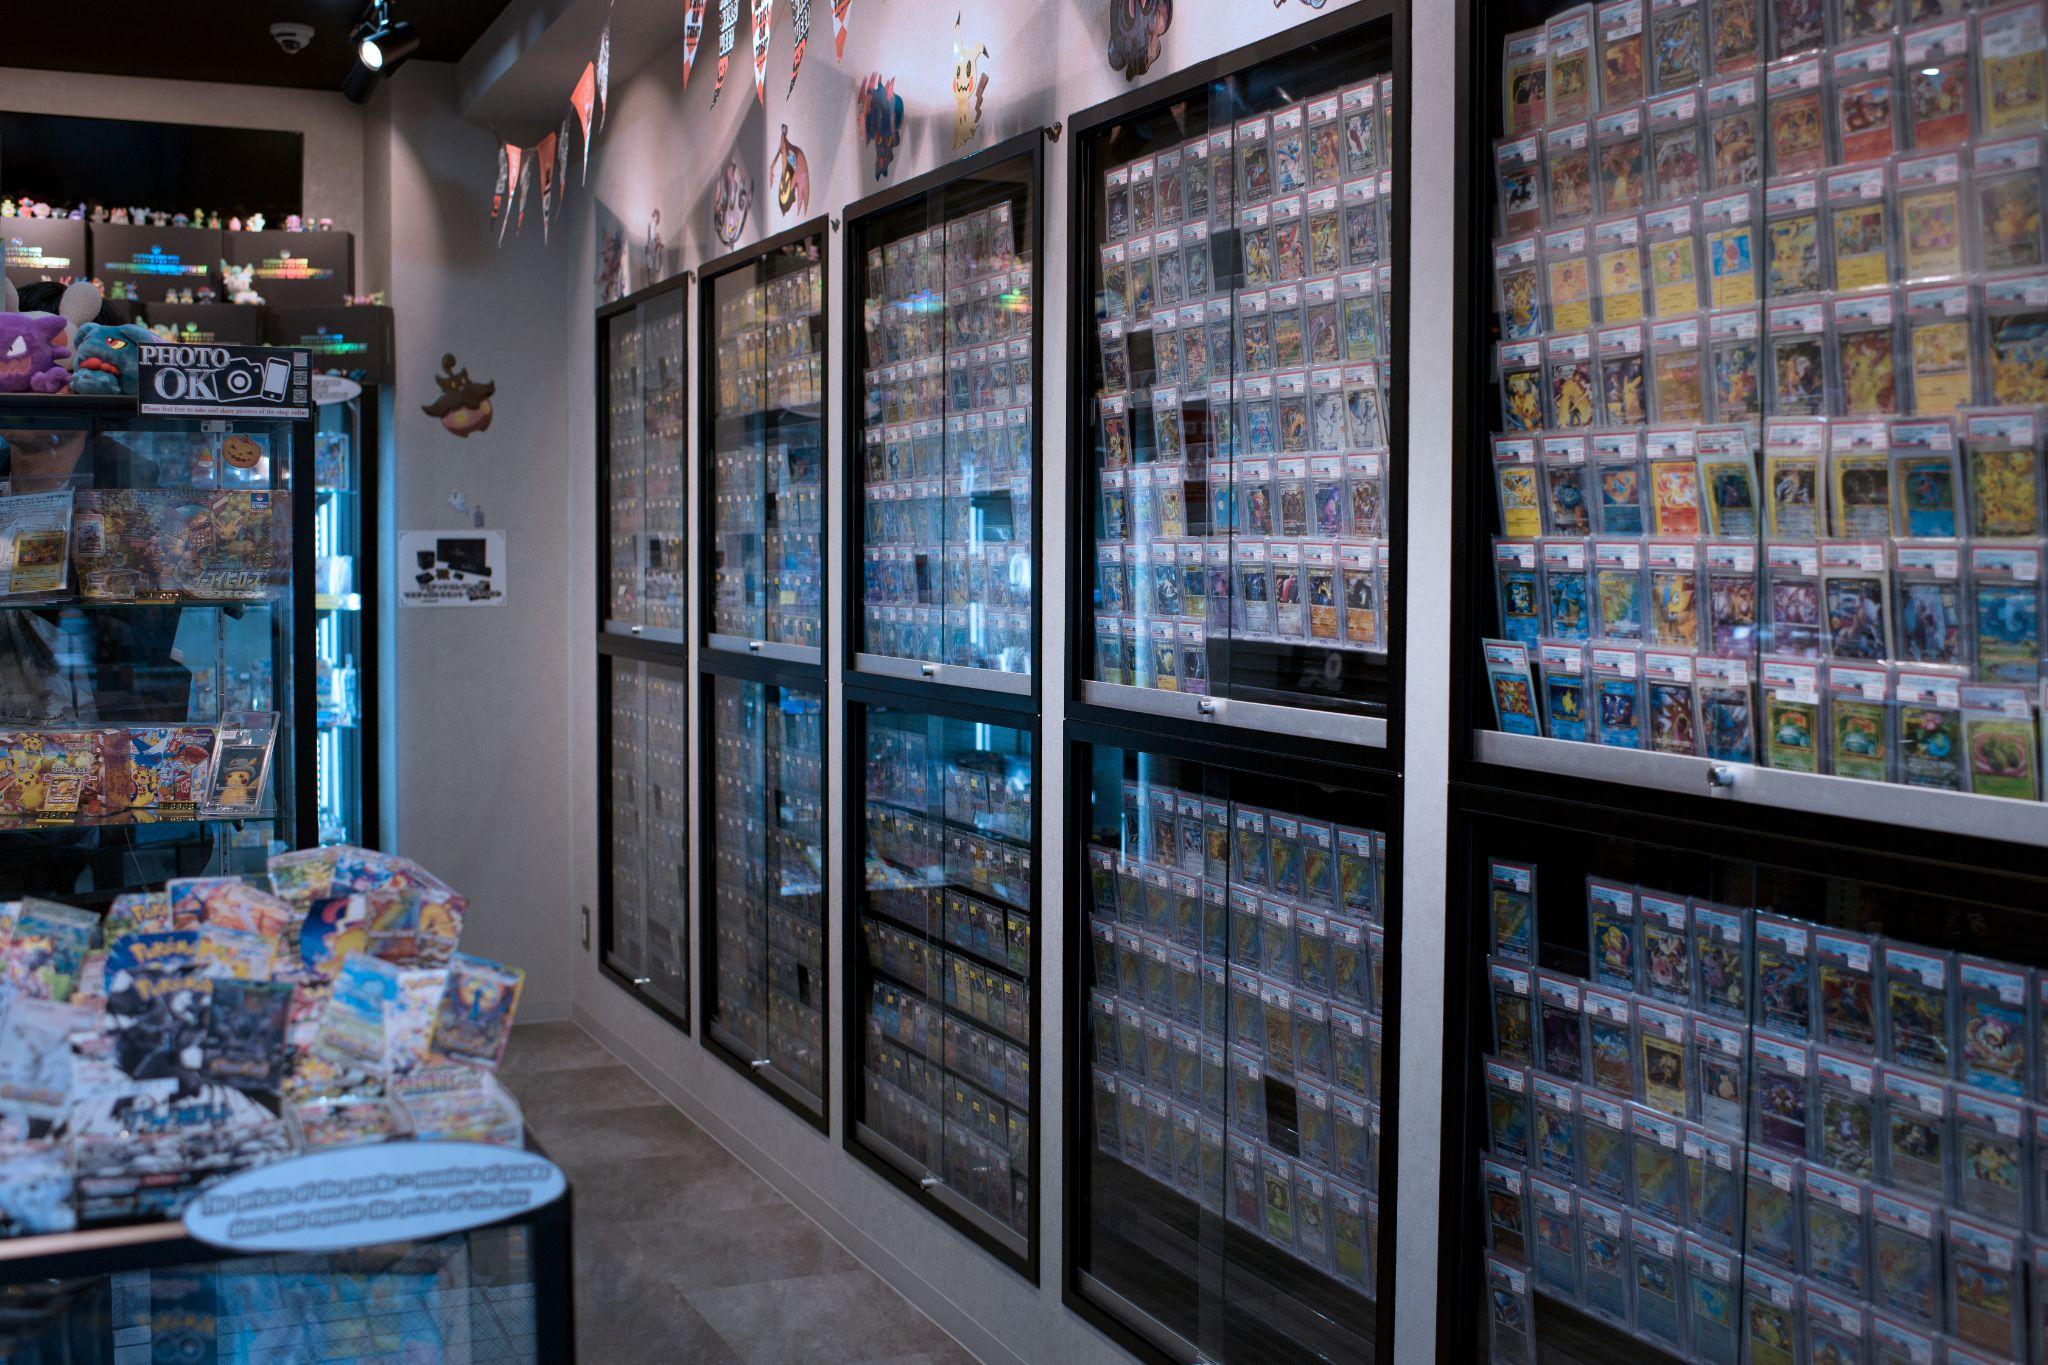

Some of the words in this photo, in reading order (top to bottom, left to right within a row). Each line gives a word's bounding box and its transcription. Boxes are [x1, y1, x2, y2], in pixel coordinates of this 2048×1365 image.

[139, 346, 231, 368] PHOTO
[154, 367, 218, 400] OK
[174, 405, 186, 413] free
[220, 406, 235, 414] share
[236, 407, 258, 416] pictures
[276, 409, 290, 417] shop
